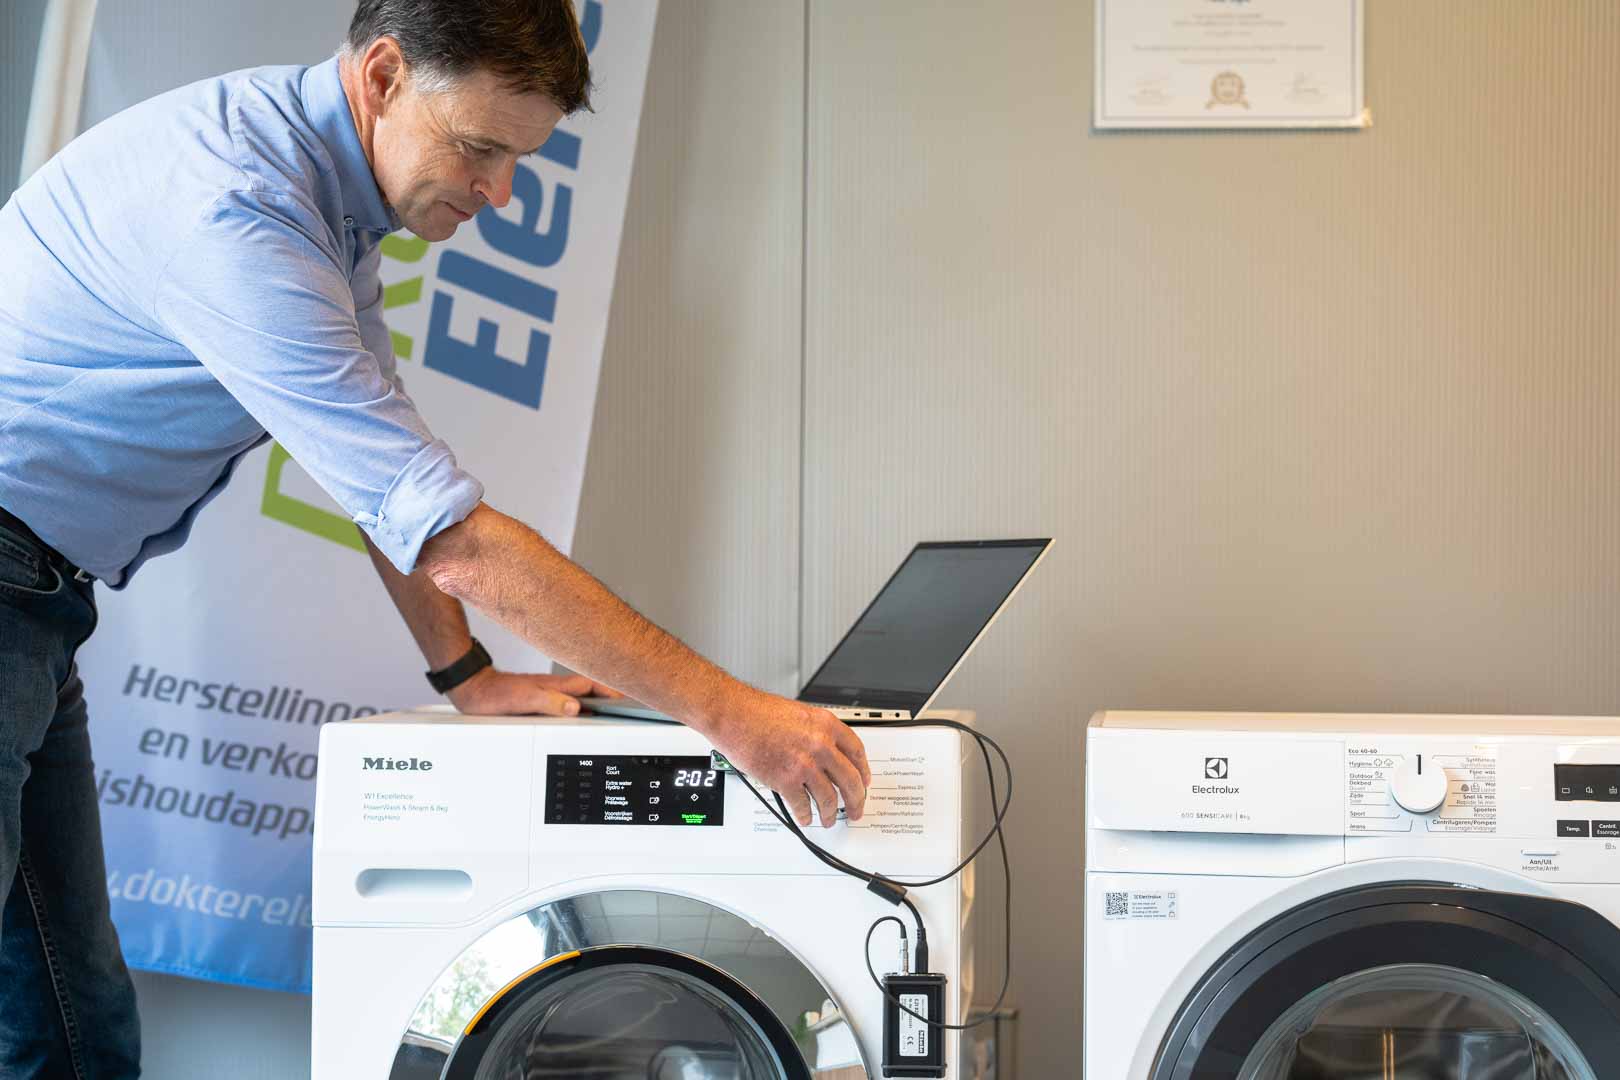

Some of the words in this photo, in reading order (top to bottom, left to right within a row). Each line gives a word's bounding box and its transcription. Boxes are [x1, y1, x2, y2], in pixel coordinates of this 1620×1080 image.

[122, 664, 392, 726] Herstellin
[138, 727, 190, 760] en
[362, 757, 433, 771] Miele
[674, 769, 717, 787] 2:02
[376, 792, 414, 800] Excellence
[1191, 785, 1240, 794] Electrolux
[97, 769, 315, 840] ishoudapp
